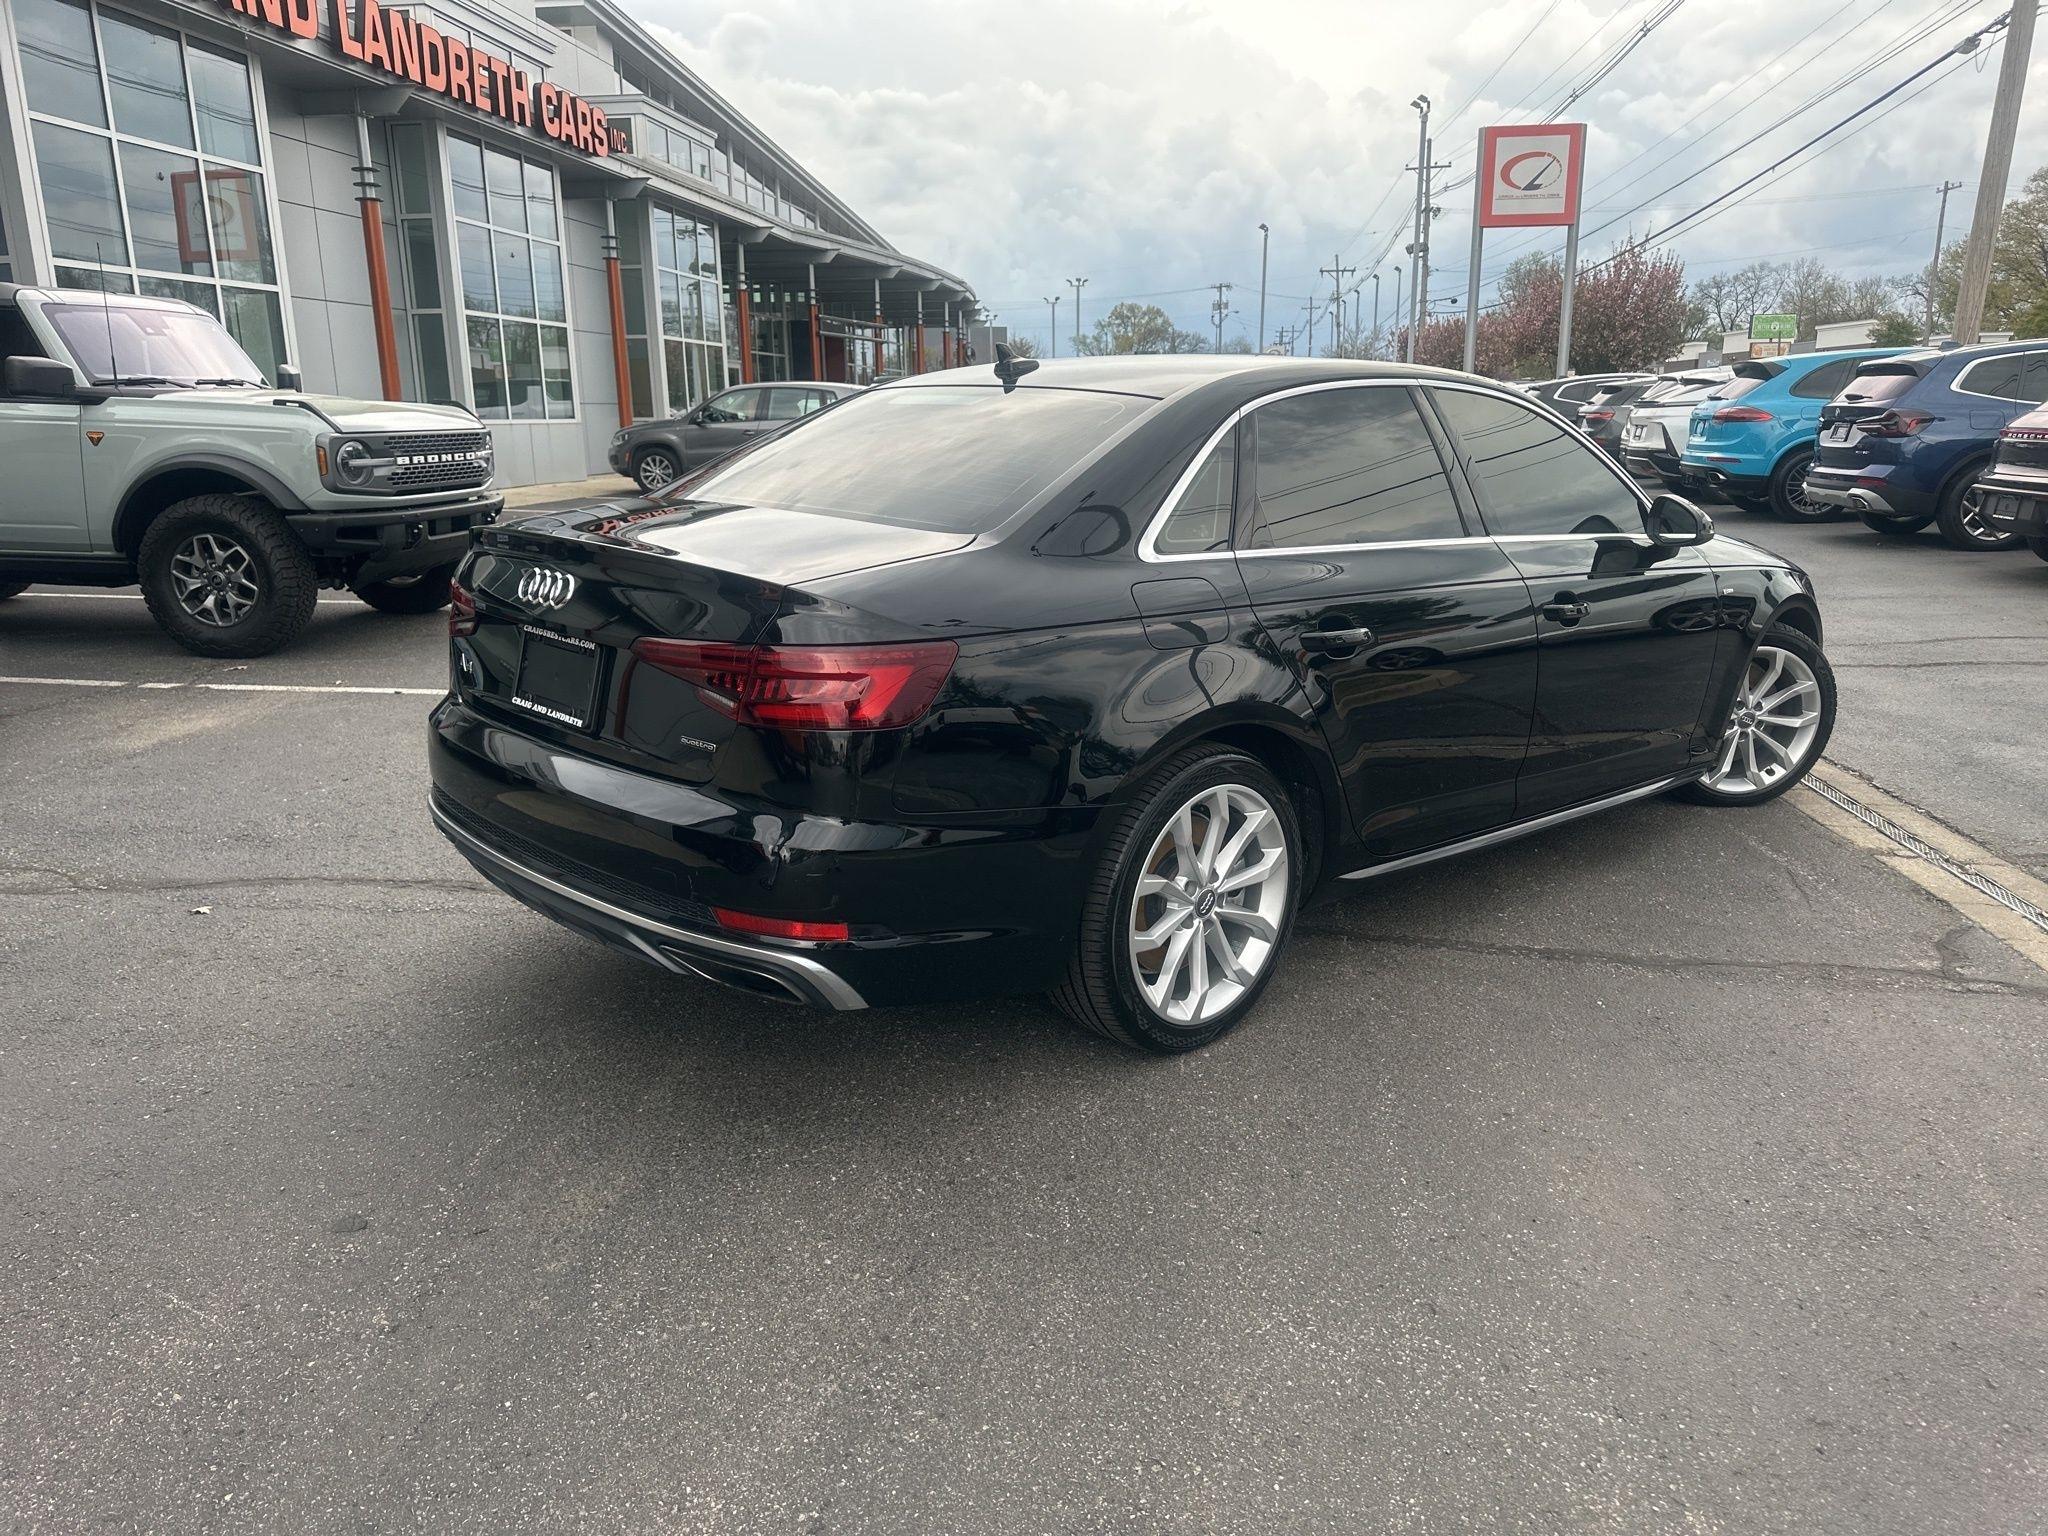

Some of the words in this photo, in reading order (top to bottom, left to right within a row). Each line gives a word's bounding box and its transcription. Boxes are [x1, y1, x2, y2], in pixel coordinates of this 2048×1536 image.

[336, 0, 532, 128] LANDRETH
[540, 82, 609, 158] CARS
[610, 127, 628, 154] INC
[396, 452, 475, 465] BRONCO
[511, 696, 533, 709] CRAIG
[532, 703, 547, 714] AND
[547, 708, 583, 728] LANDRETH
[680, 737, 714, 751] quattro
